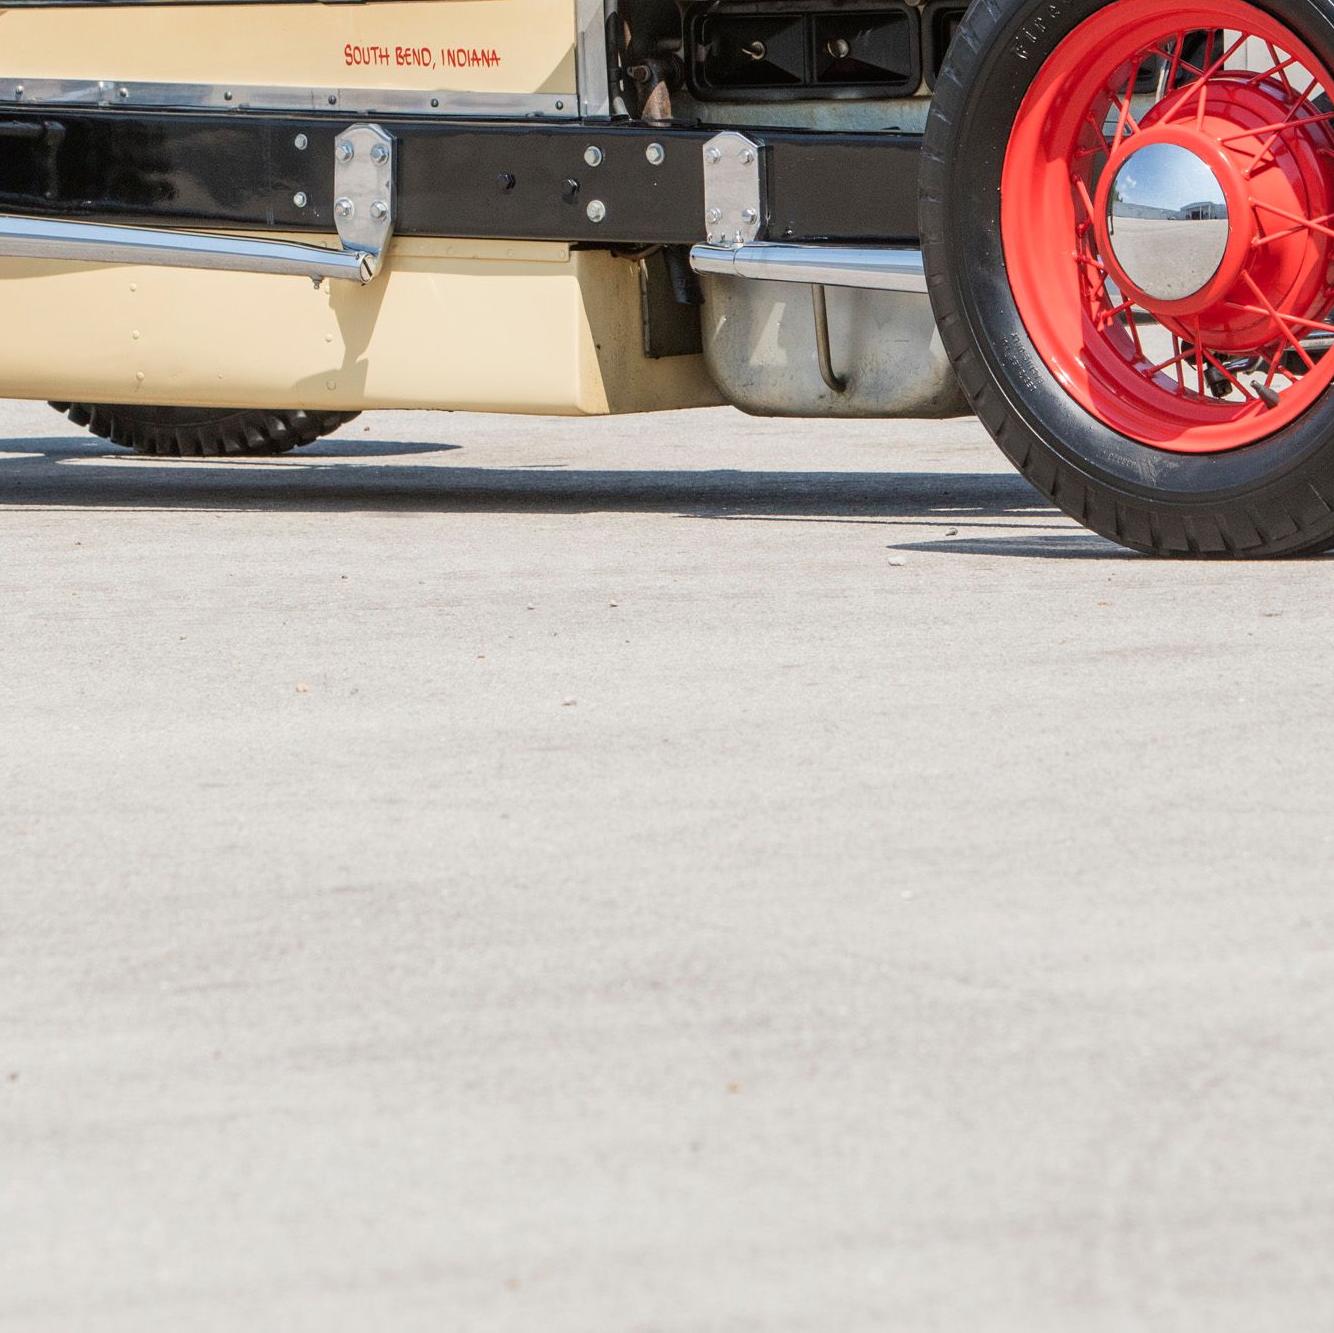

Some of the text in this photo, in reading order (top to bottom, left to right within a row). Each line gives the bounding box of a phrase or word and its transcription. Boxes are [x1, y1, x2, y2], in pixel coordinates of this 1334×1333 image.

[343, 43, 501, 70] SOUTH BEND, INDIANA
